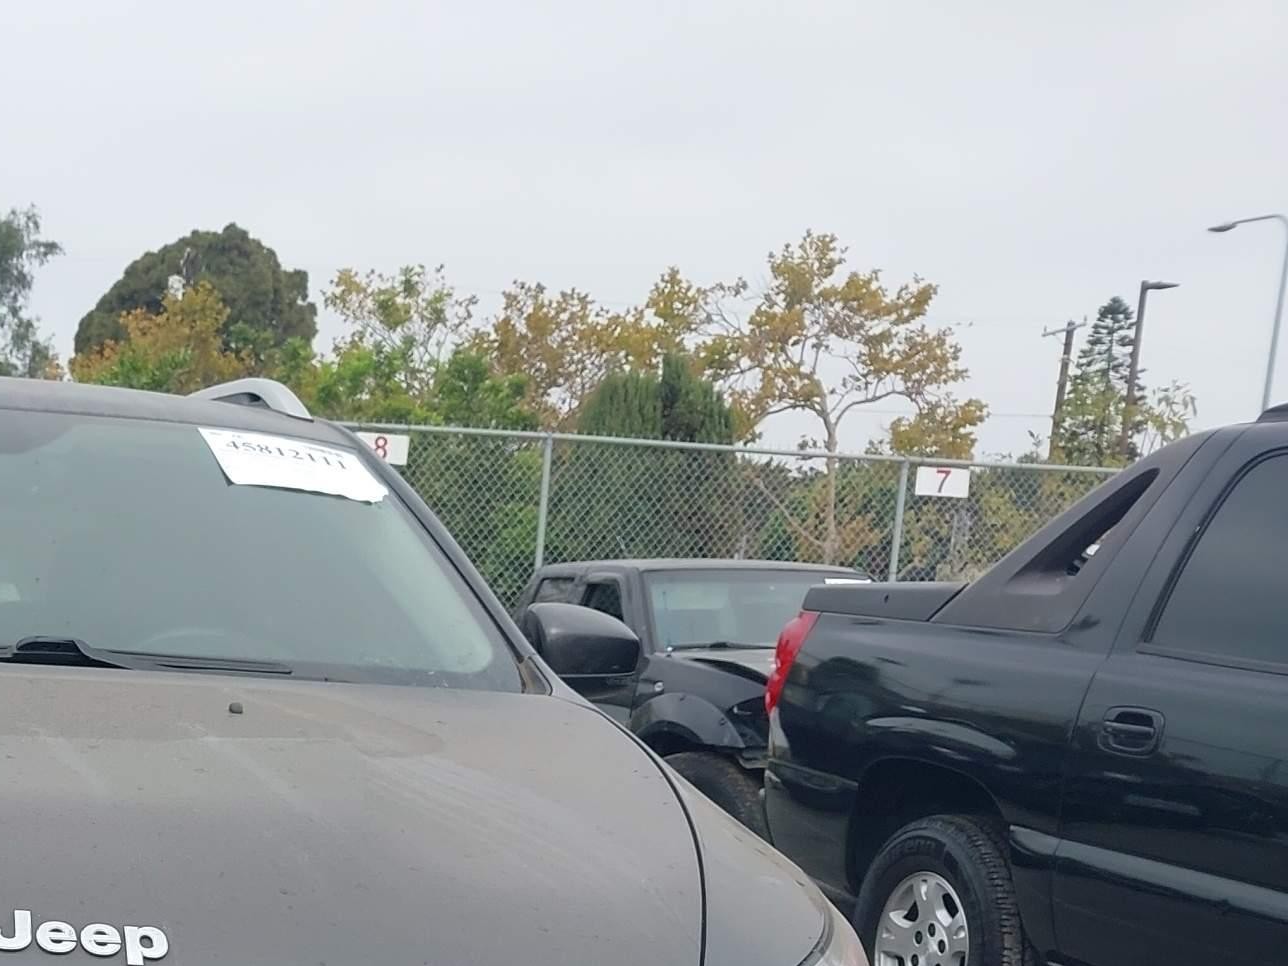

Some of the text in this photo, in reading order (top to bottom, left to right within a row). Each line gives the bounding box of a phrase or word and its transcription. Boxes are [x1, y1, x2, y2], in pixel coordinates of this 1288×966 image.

[226, 440, 347, 470] 45812111
[374, 436, 388, 459] 8
[936, 469, 952, 493] 7
